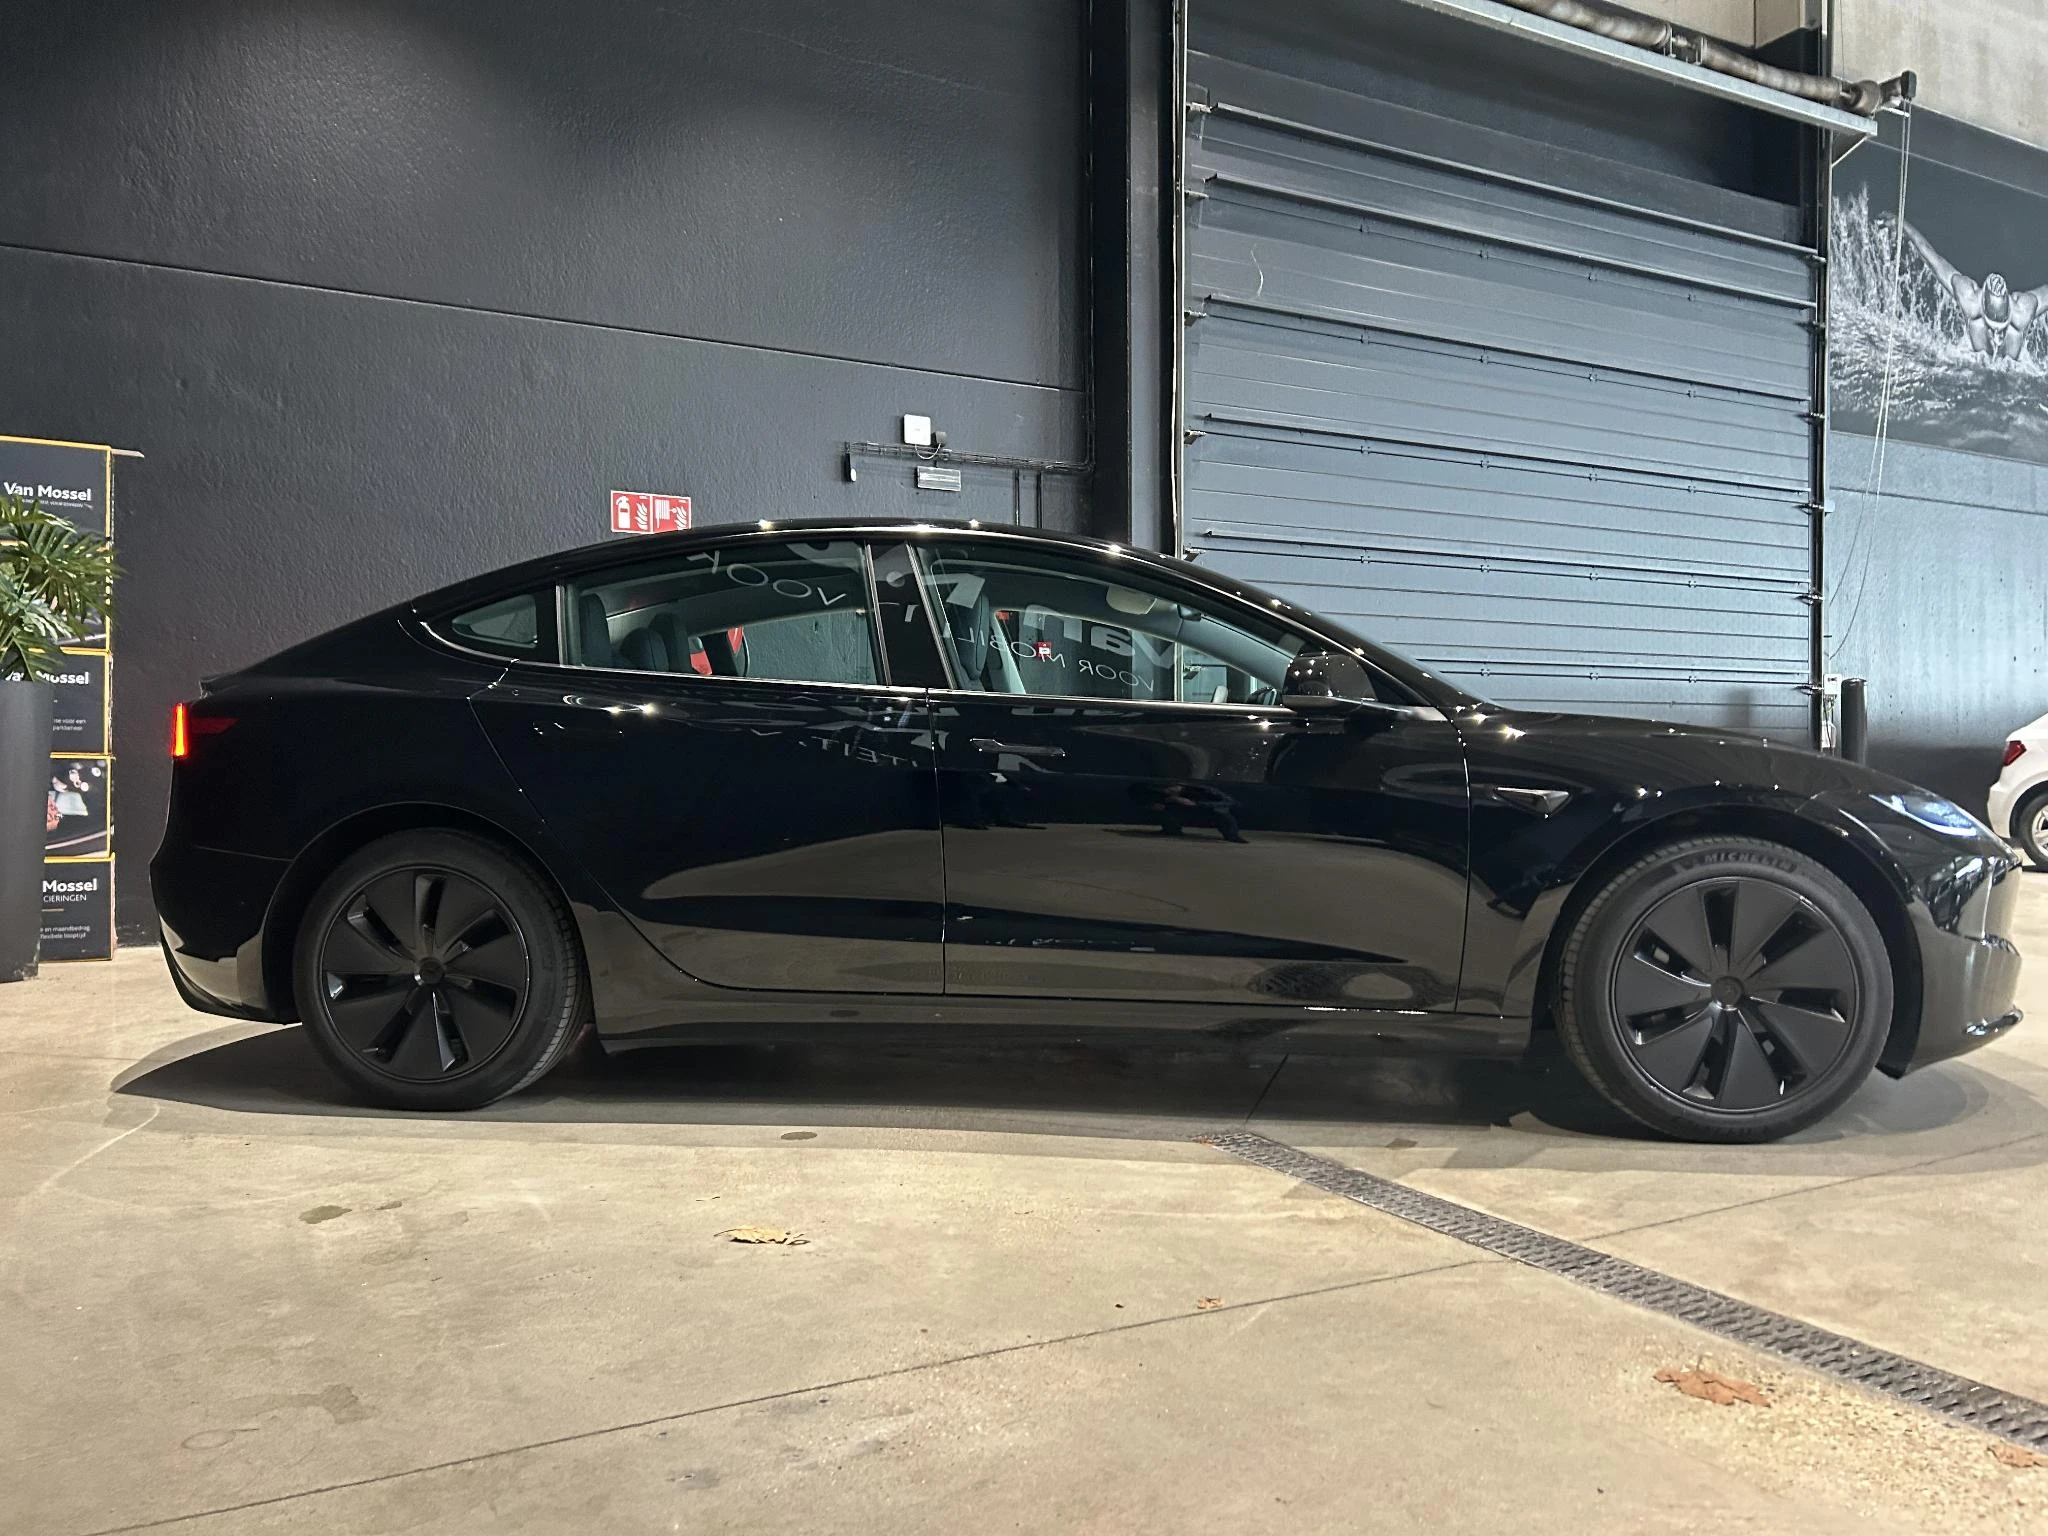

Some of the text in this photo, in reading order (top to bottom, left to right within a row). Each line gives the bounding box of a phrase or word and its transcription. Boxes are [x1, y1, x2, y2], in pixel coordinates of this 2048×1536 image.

[3, 481, 92, 501] Van Mossel
[1704, 852, 1793, 871] MICHELIN
[42, 878, 98, 893] Mossel
